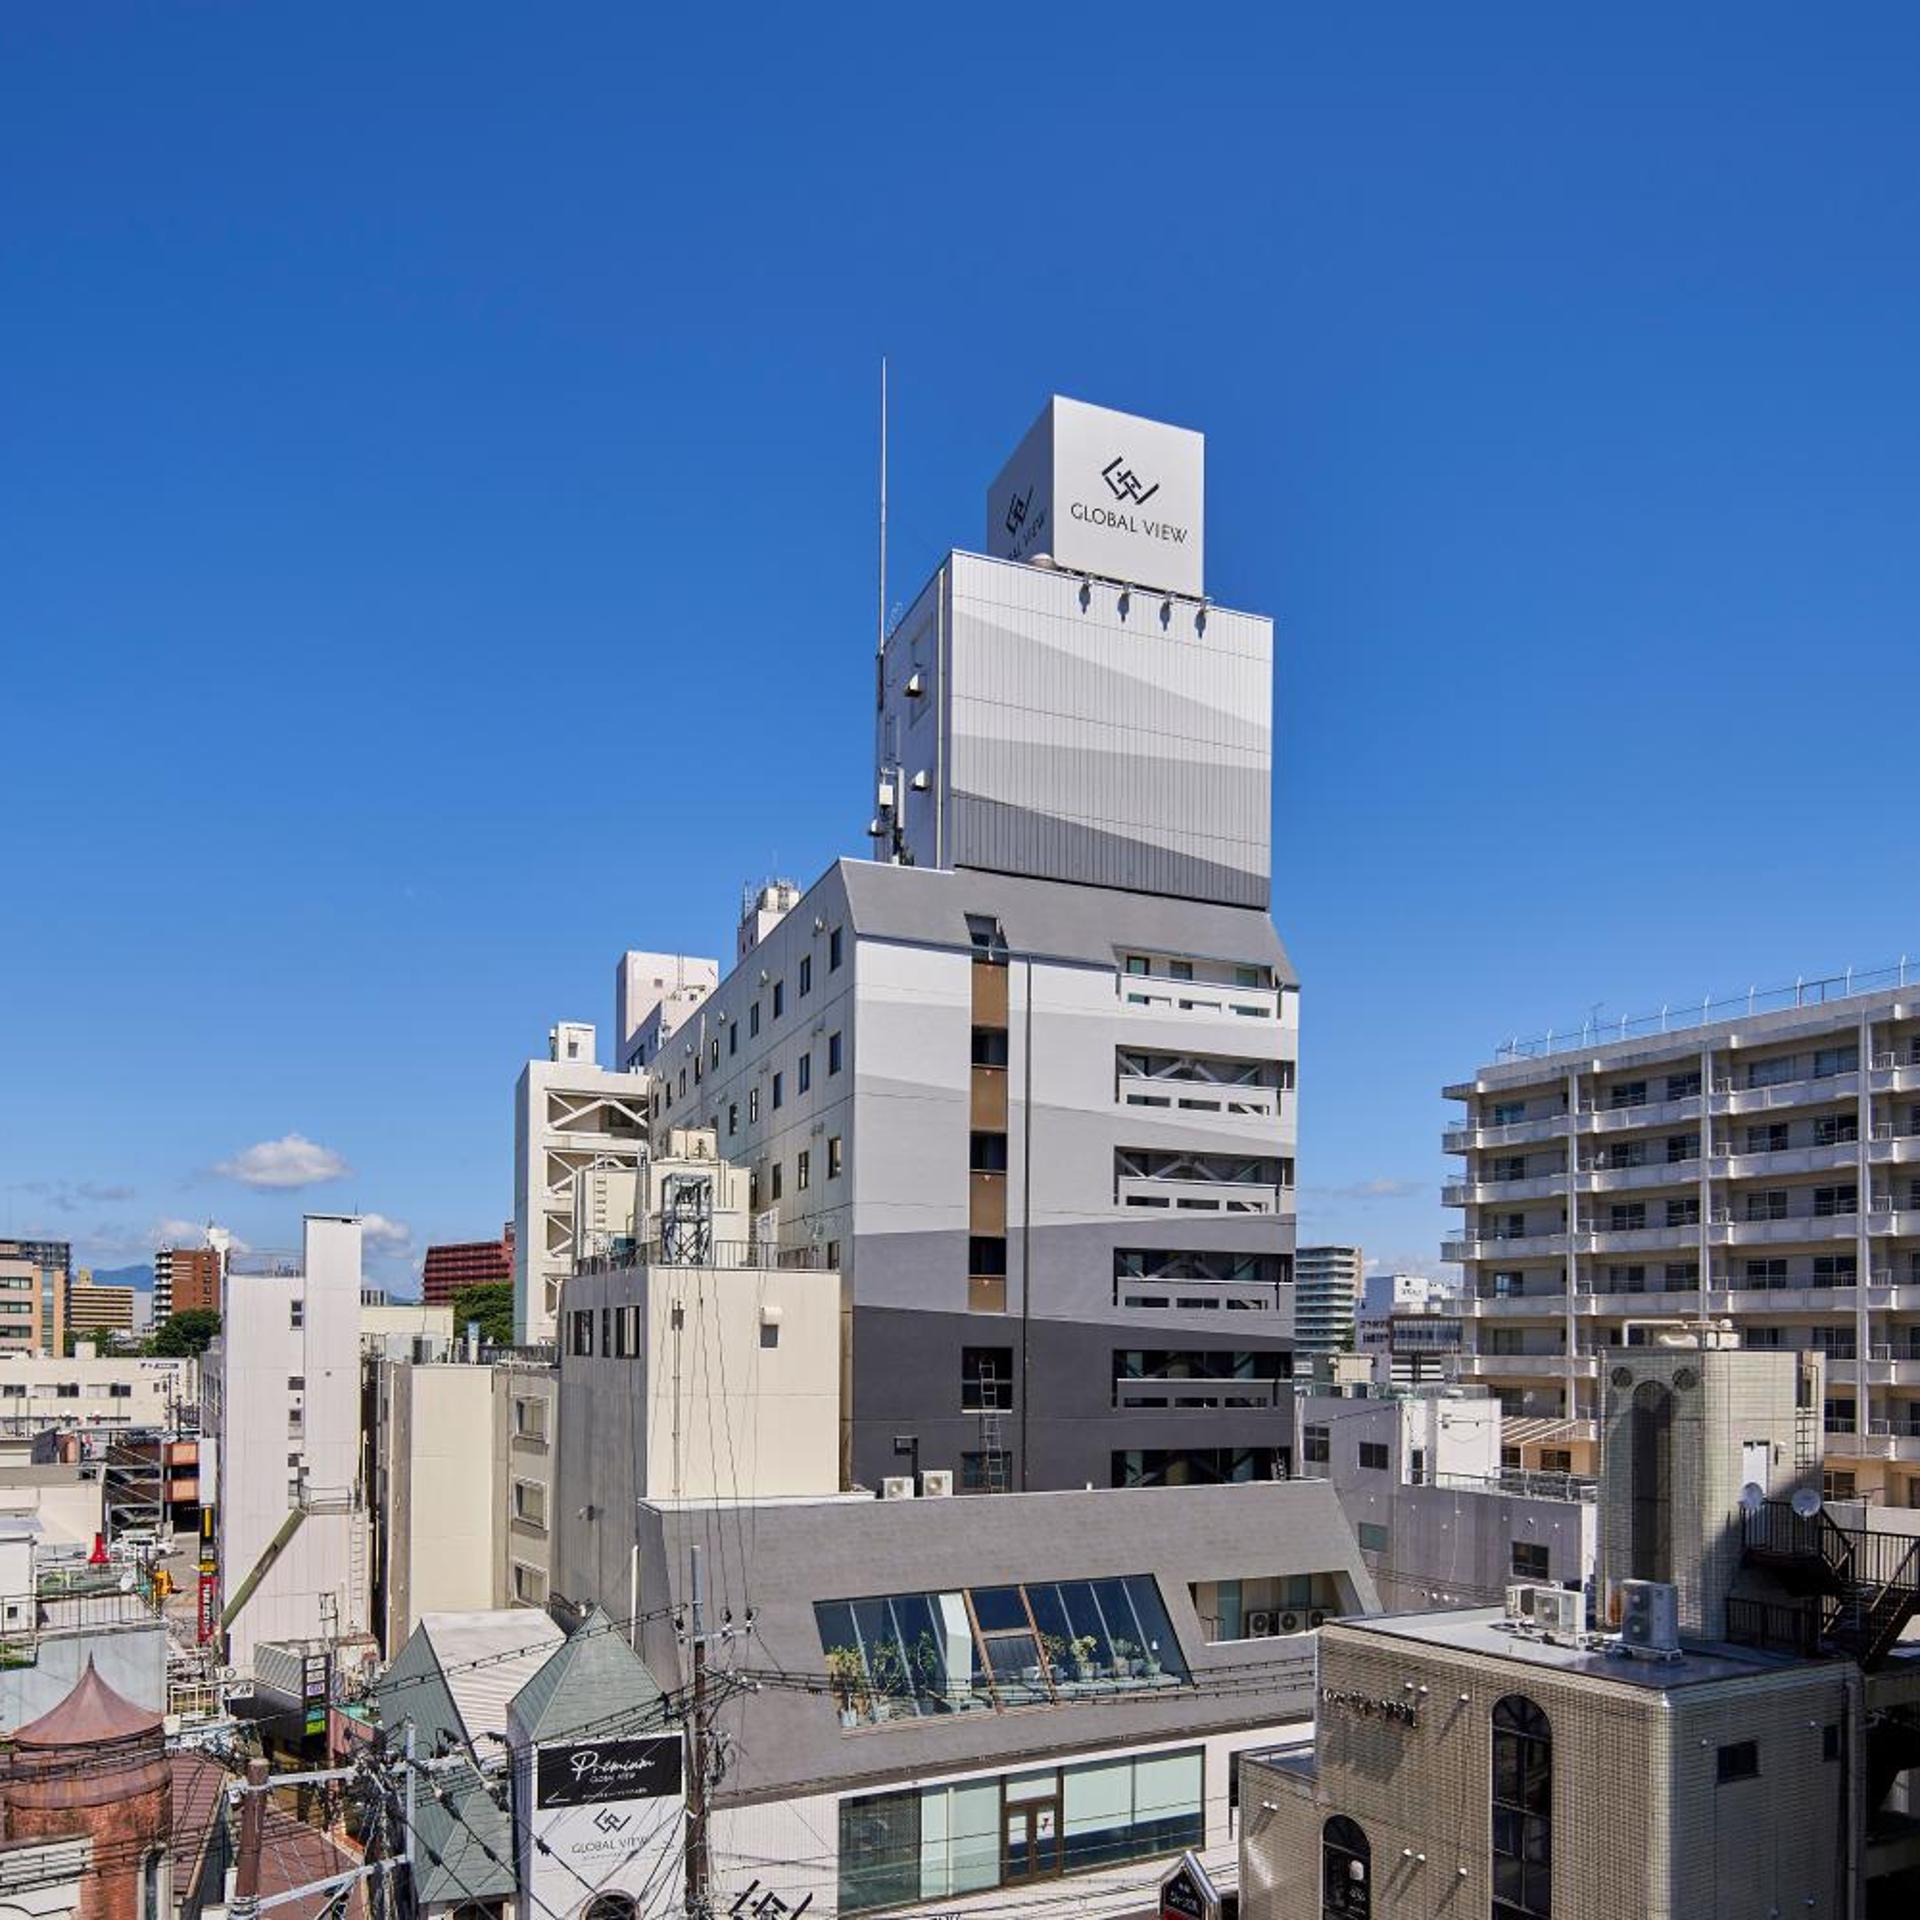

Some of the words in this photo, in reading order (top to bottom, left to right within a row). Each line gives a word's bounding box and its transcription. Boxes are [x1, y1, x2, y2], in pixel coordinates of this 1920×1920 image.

[1070, 502, 1137, 532] GLOBAL
[1143, 520, 1187, 543] VIEW
[570, 1751, 655, 1781] Premium
[571, 1840, 615, 1853] GLOBAL
[619, 1836, 648, 1848] VIEW
